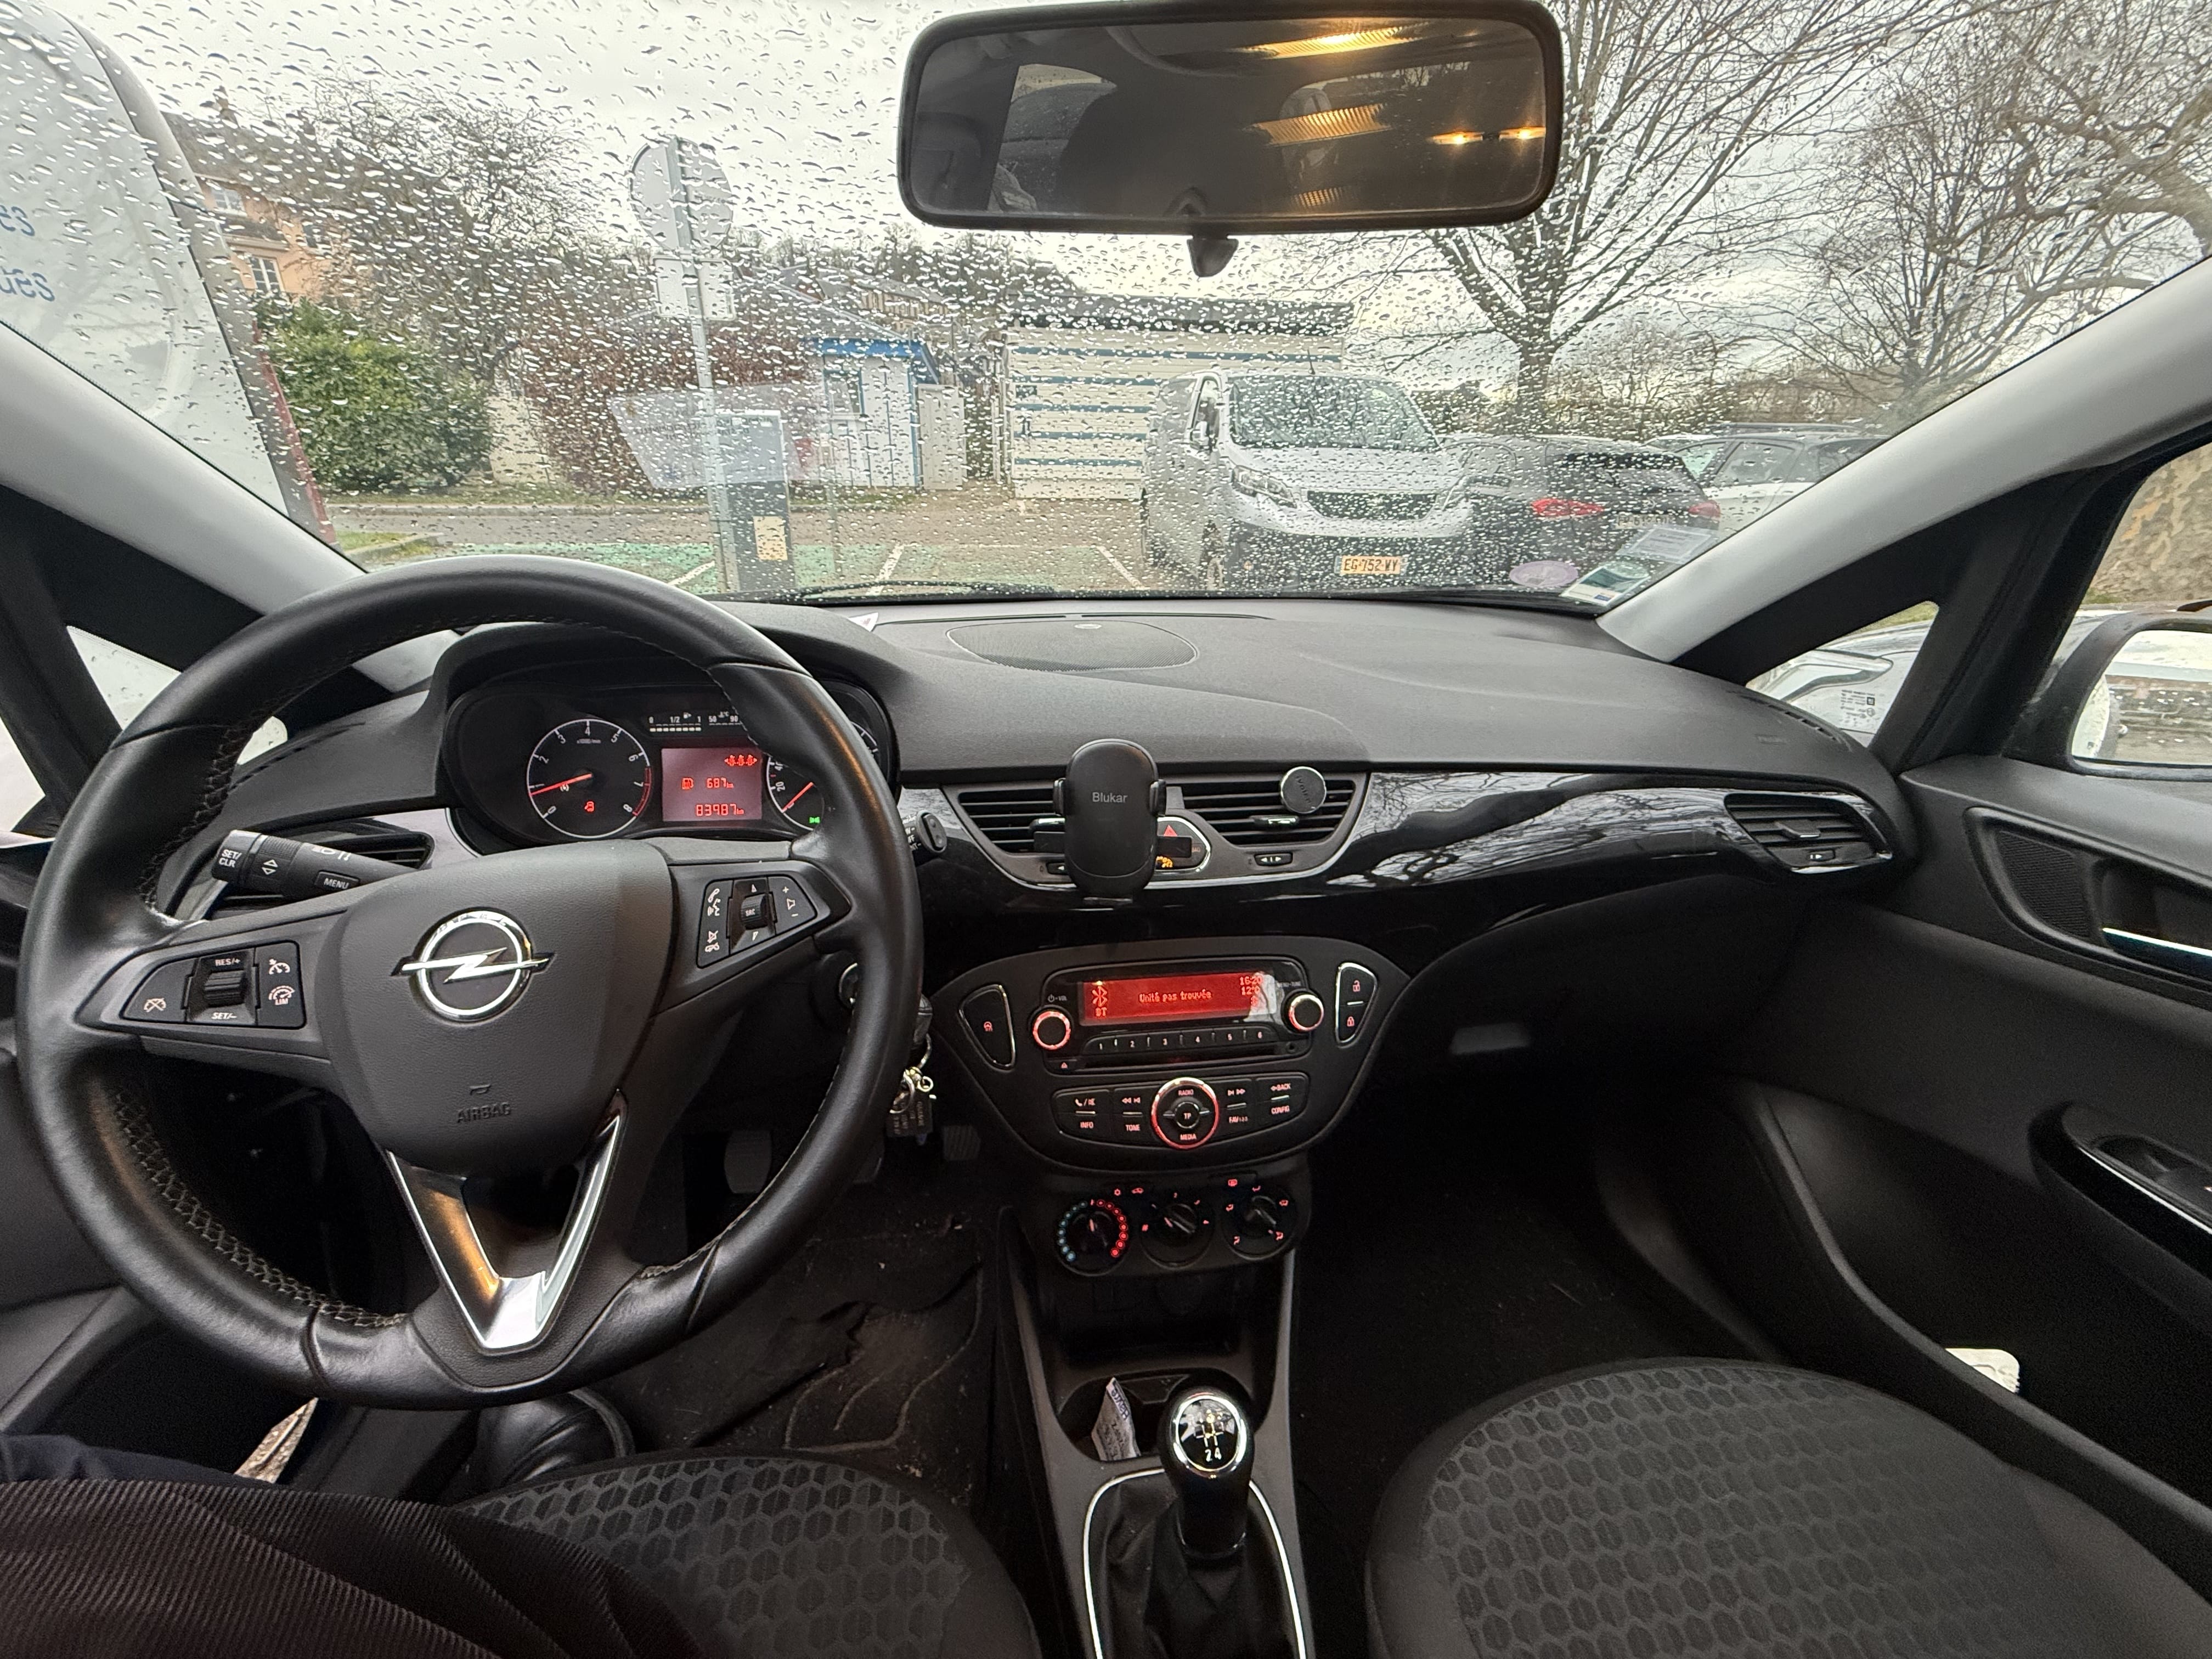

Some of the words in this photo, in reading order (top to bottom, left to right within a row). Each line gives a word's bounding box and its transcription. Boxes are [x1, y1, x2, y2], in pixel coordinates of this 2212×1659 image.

[585, 727, 590, 736] 4
[557, 734, 566, 743] 3
[611, 734, 619, 743] 5
[539, 755, 549, 764] 2
[775, 781, 785, 792] 20
[1092, 792, 1128, 803] Blukar
[548, 805, 556, 814] 0
[623, 804, 632, 812] 8
[221, 849, 242, 860] SET/
[218, 857, 235, 868] CLR
[324, 878, 349, 889] MENU
[1139, 992, 1160, 1003] Unité
[1163, 993, 1177, 1002] pas
[1095, 1007, 1107, 1017] BT
[456, 1102, 512, 1124] AIRBAG
[1271, 1106, 1290, 1115] CONFIG
[1111, 1389, 1130, 1420] Havre
[1205, 1449, 1212, 1462] 2
[1214, 1447, 1222, 1460] 4
